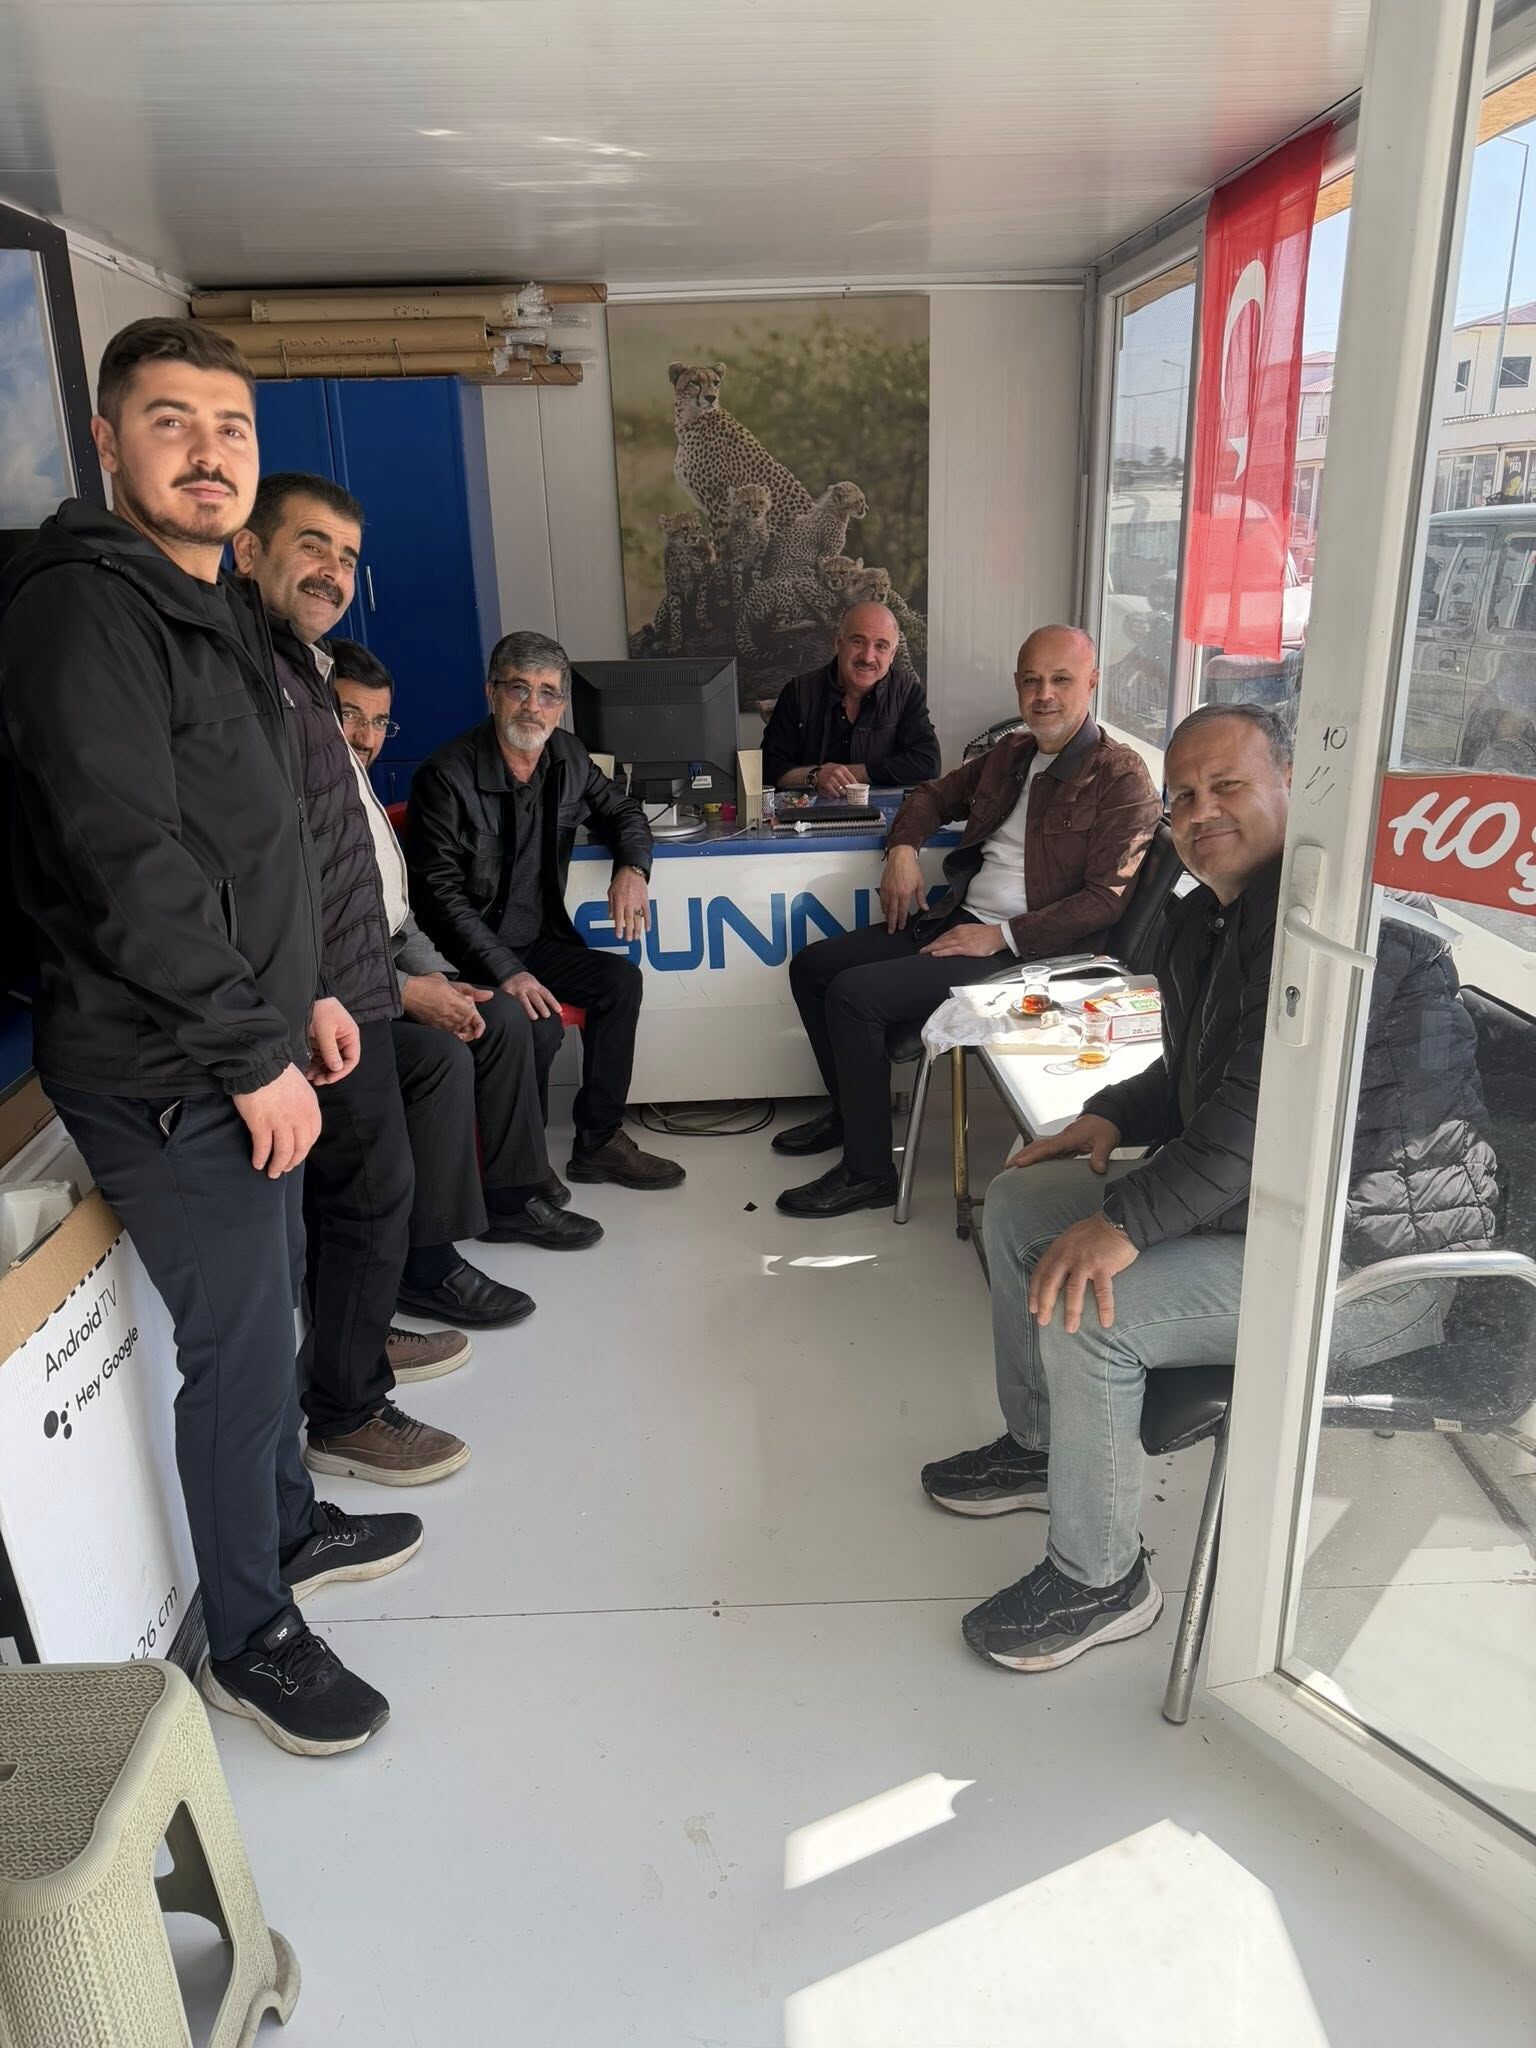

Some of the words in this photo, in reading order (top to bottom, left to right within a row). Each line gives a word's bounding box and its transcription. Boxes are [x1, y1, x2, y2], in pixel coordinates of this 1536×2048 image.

[1323, 725, 1347, 751] 10
[45, 1302, 102, 1382] Android
[99, 1279, 117, 1316] TV
[75, 1374, 101, 1412] Hey
[101, 1326, 139, 1379] Google
[129, 1619, 157, 1660] 26
[158, 1586, 178, 1627] cm
